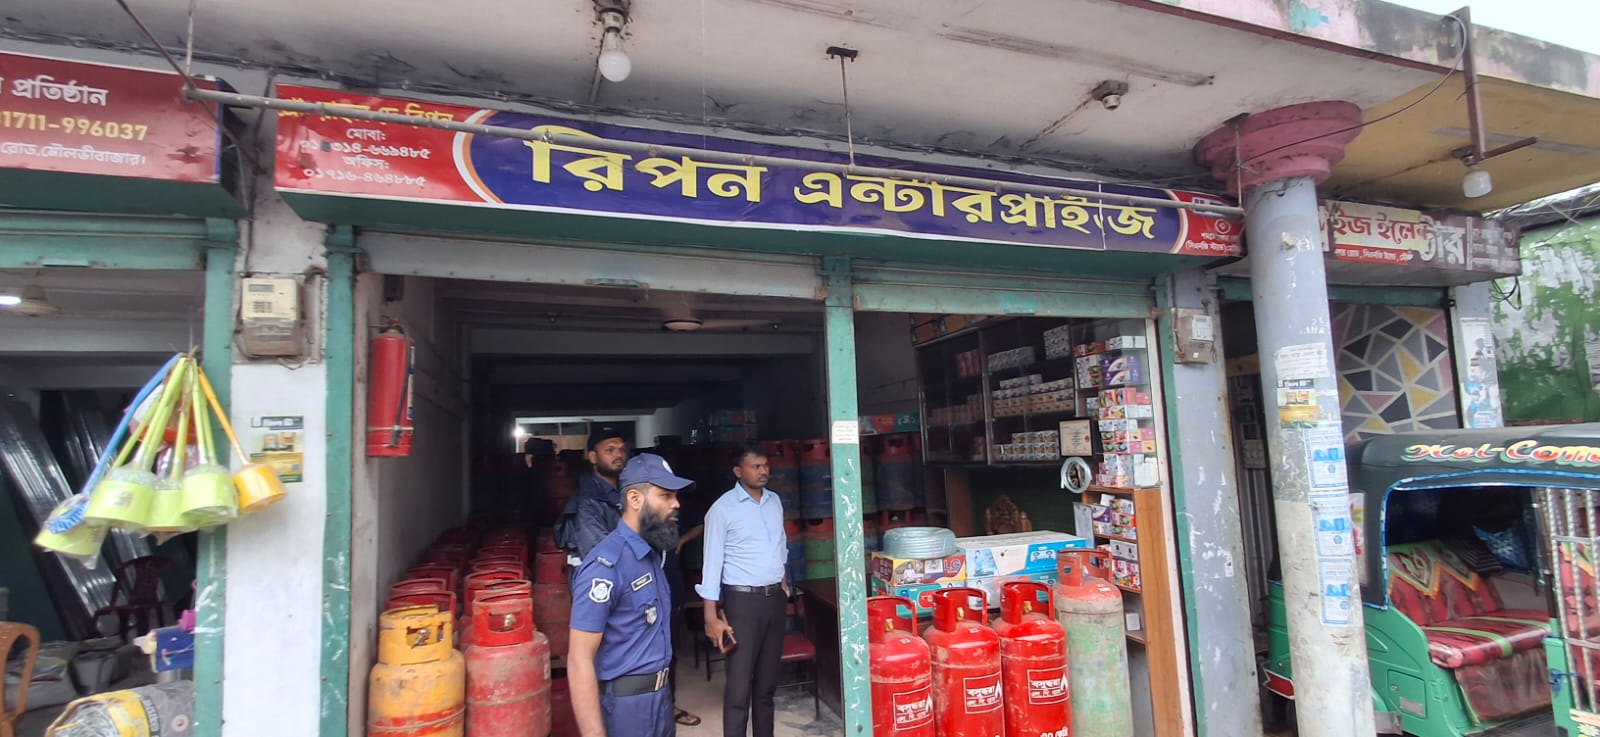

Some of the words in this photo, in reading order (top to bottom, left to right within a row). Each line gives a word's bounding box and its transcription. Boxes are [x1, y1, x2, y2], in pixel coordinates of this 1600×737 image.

[12, 74, 109, 106] প্রতিষ্ঠান
[0, 110, 148, 141] 1711-996037
[299, 140, 431, 159] ০১৩১৪-৬৬৯৪৮৫
[522, 124, 768, 203] রিপন
[792, 172, 1157, 240] এন্টারপ্রাইজ
